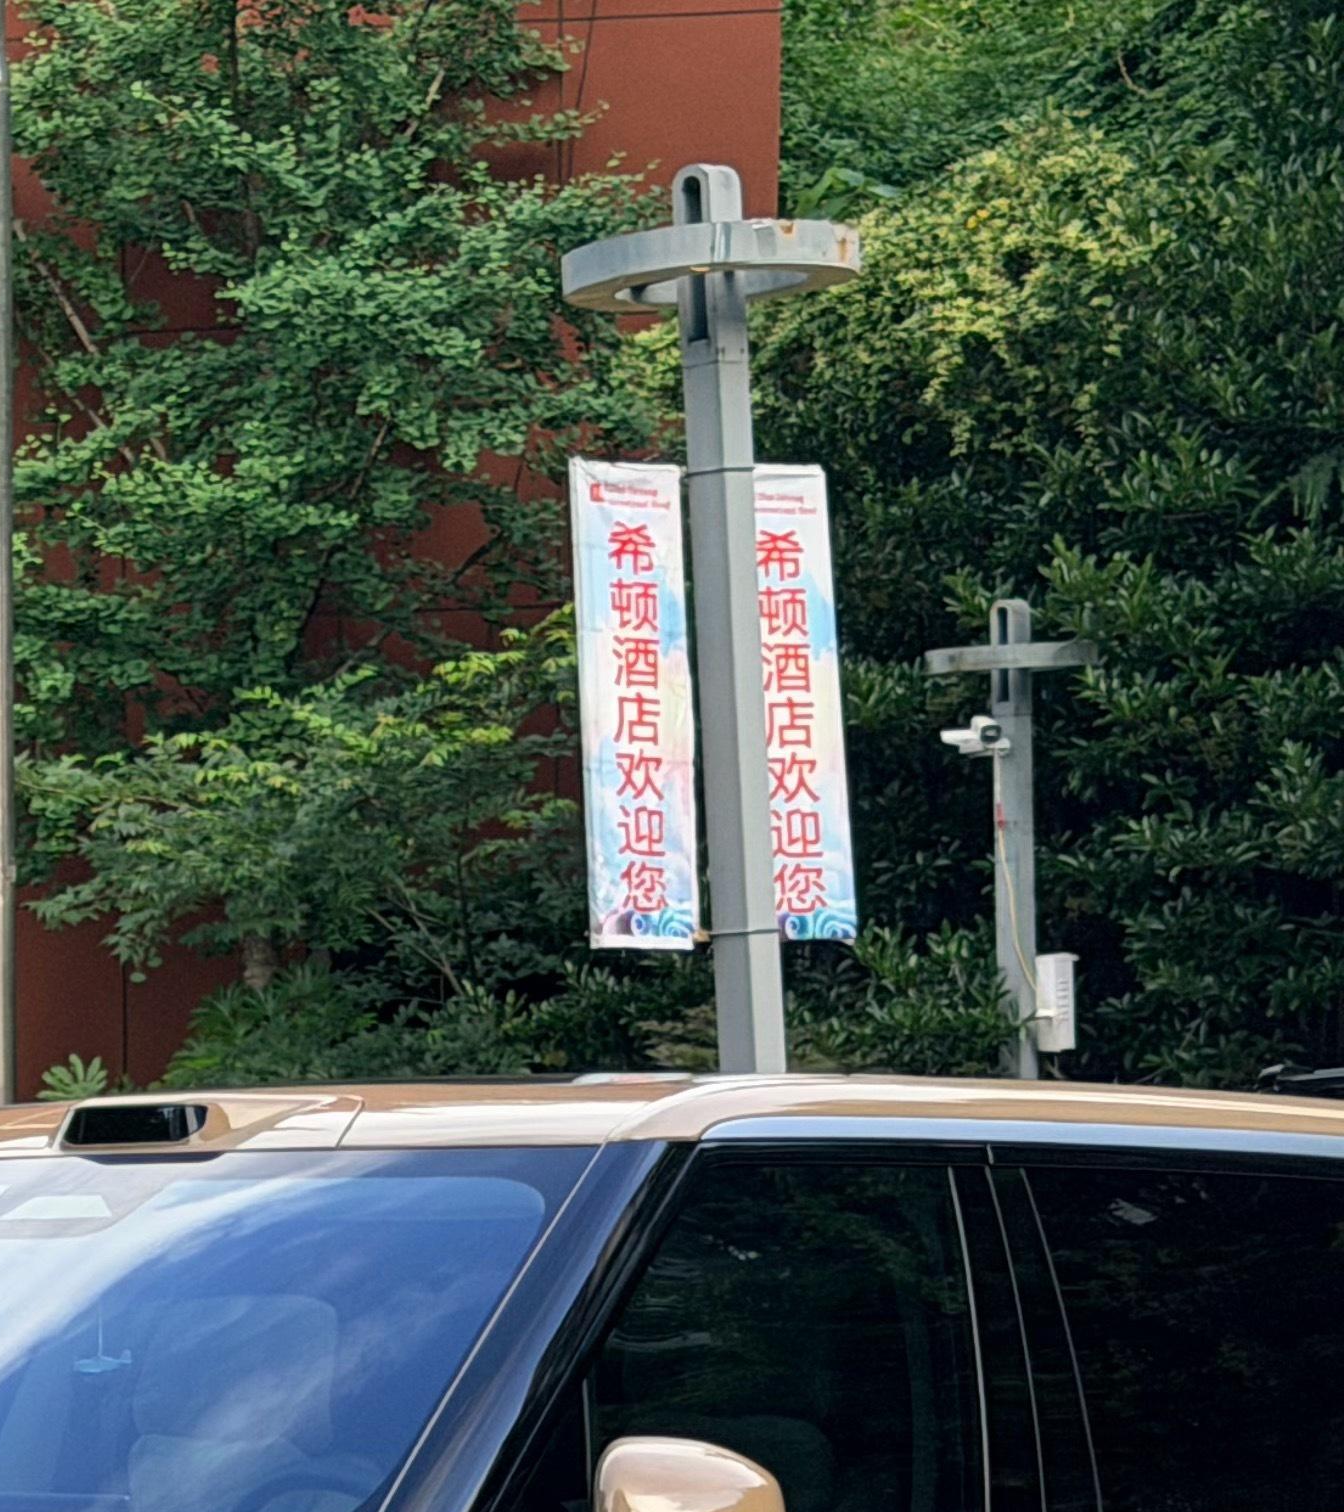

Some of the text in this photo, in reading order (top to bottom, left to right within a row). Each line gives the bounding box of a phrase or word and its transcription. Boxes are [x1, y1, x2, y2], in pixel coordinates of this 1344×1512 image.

[607, 521, 668, 914] 希顿酒店欢迎您
[756, 529, 828, 914] 希顿酒店欢迎您
